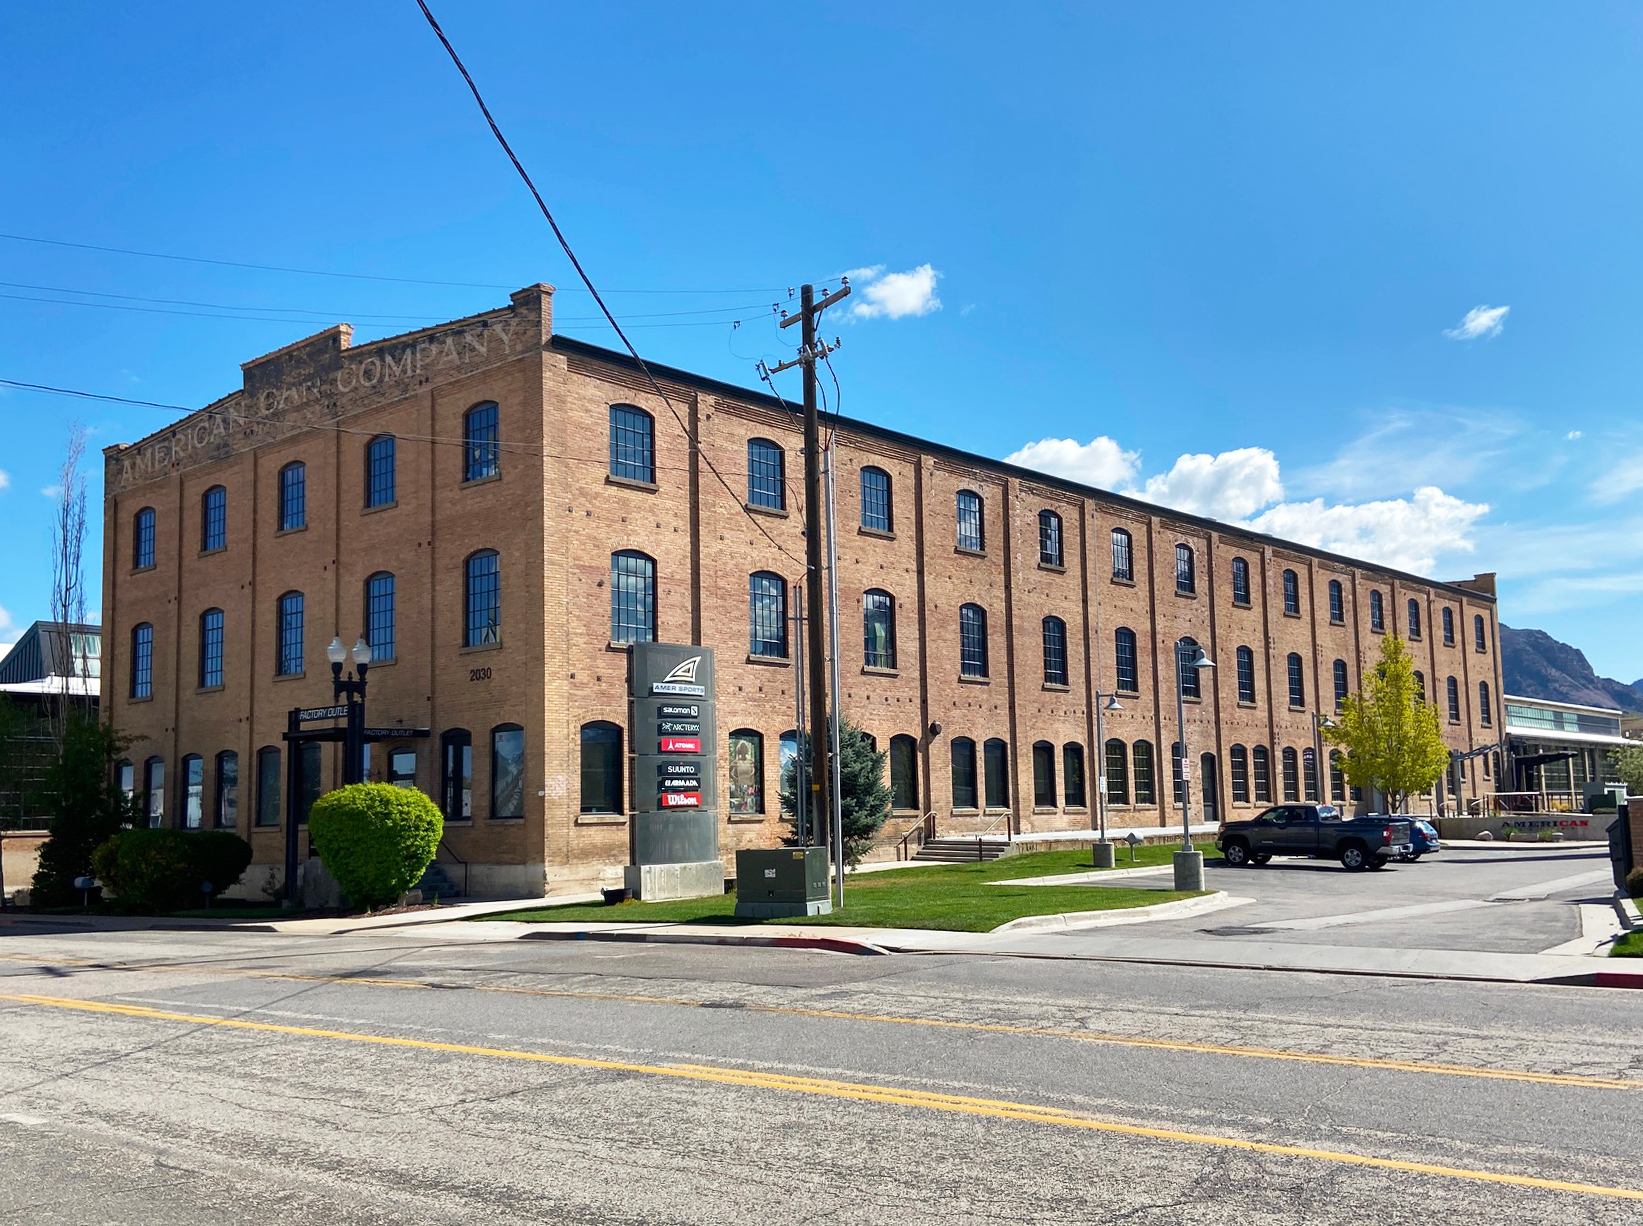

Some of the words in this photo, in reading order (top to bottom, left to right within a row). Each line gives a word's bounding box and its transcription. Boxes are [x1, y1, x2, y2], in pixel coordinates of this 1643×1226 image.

[120, 400, 246, 487] AMERICAN
[259, 376, 321, 417] CAN
[337, 319, 518, 393] COMPANY
[469, 667, 492, 682] 2030
[299, 708, 327, 721] FACTORY
[328, 706, 348, 717] OUTLE
[363, 729, 390, 737] FACTORY
[668, 794, 698, 805] Wilson
